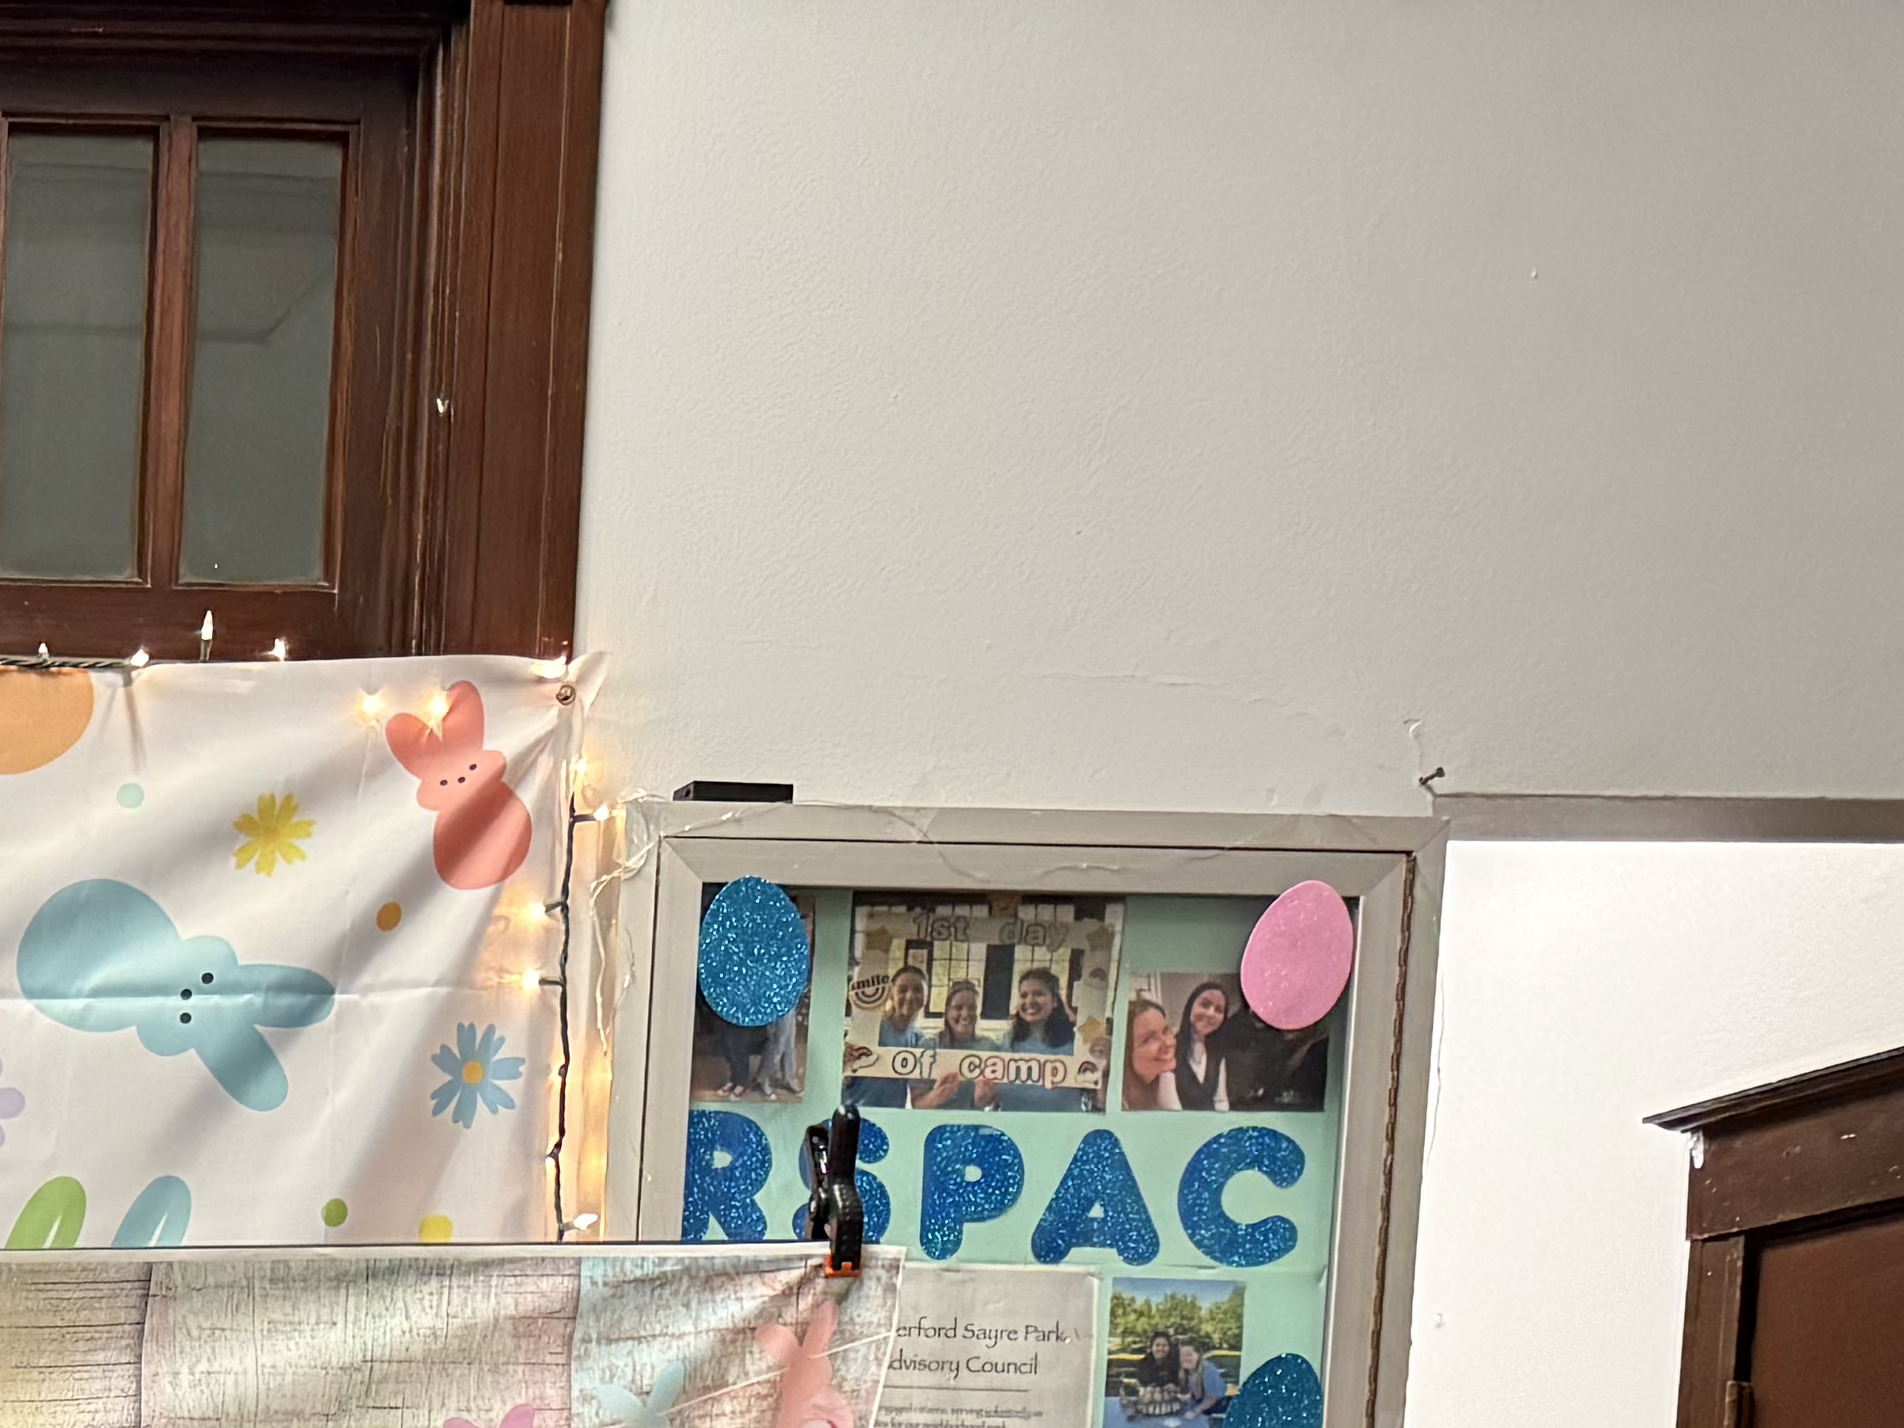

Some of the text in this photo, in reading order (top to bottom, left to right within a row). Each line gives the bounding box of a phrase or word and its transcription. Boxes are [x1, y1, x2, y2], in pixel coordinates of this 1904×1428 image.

[913, 914, 1069, 951] 1st day
[892, 1050, 1068, 1089] of camp
[896, 1316, 957, 1339] erford
[962, 1323, 1018, 1348] Sayre
[966, 1353, 1038, 1375] Council
